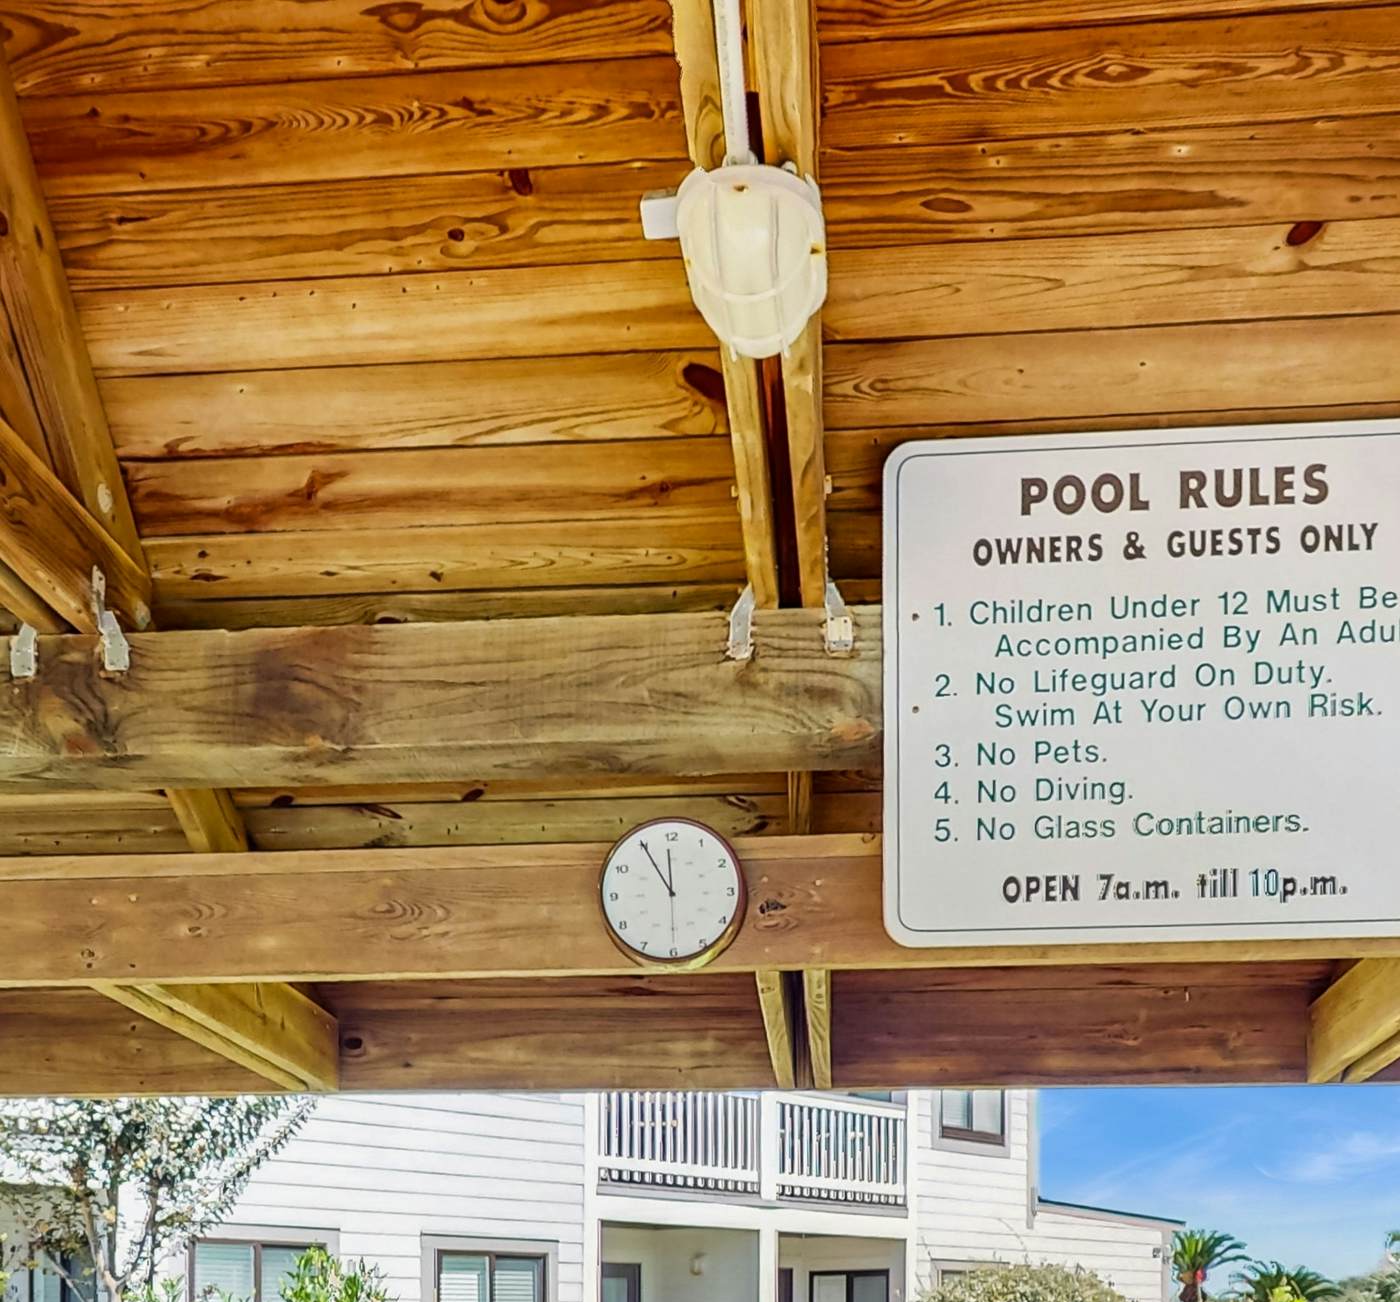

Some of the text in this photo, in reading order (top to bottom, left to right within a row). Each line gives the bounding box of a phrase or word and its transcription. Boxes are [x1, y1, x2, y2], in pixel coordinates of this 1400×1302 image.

[1021, 463, 1329, 516] POOL RULES
[973, 522, 1378, 567] OWNERS & GUESTS ONLY
[934, 586, 1398, 626] 1. Children Under 12 Must Be
[994, 626, 1203, 659] Accompanied
[1223, 626, 1261, 653] By
[1279, 622, 1317, 645] An
[935, 660, 1332, 697] 2. No Lifeguard On Duty.
[995, 692, 1382, 728] Swim At Your Own Risk.
[935, 740, 1107, 768] 3. No Pets.
[934, 776, 1133, 805] 4. No Diving.
[934, 810, 1309, 842] 5. No Glass Containers.
[665, 831, 679, 842] 12
[699, 838, 704, 847] 1
[717, 858, 727, 868] 2
[616, 865, 629, 873] 10
[726, 887, 735, 896] 3
[1002, 868, 1348, 904] OPEN 7a.m. till 10p.m.
[609, 892, 619, 901] 9
[619, 920, 627, 929] 8
[718, 916, 727, 924] 4
[640, 941, 648, 950] 7
[699, 938, 707, 948] 5
[669, 949, 678, 957] 6
